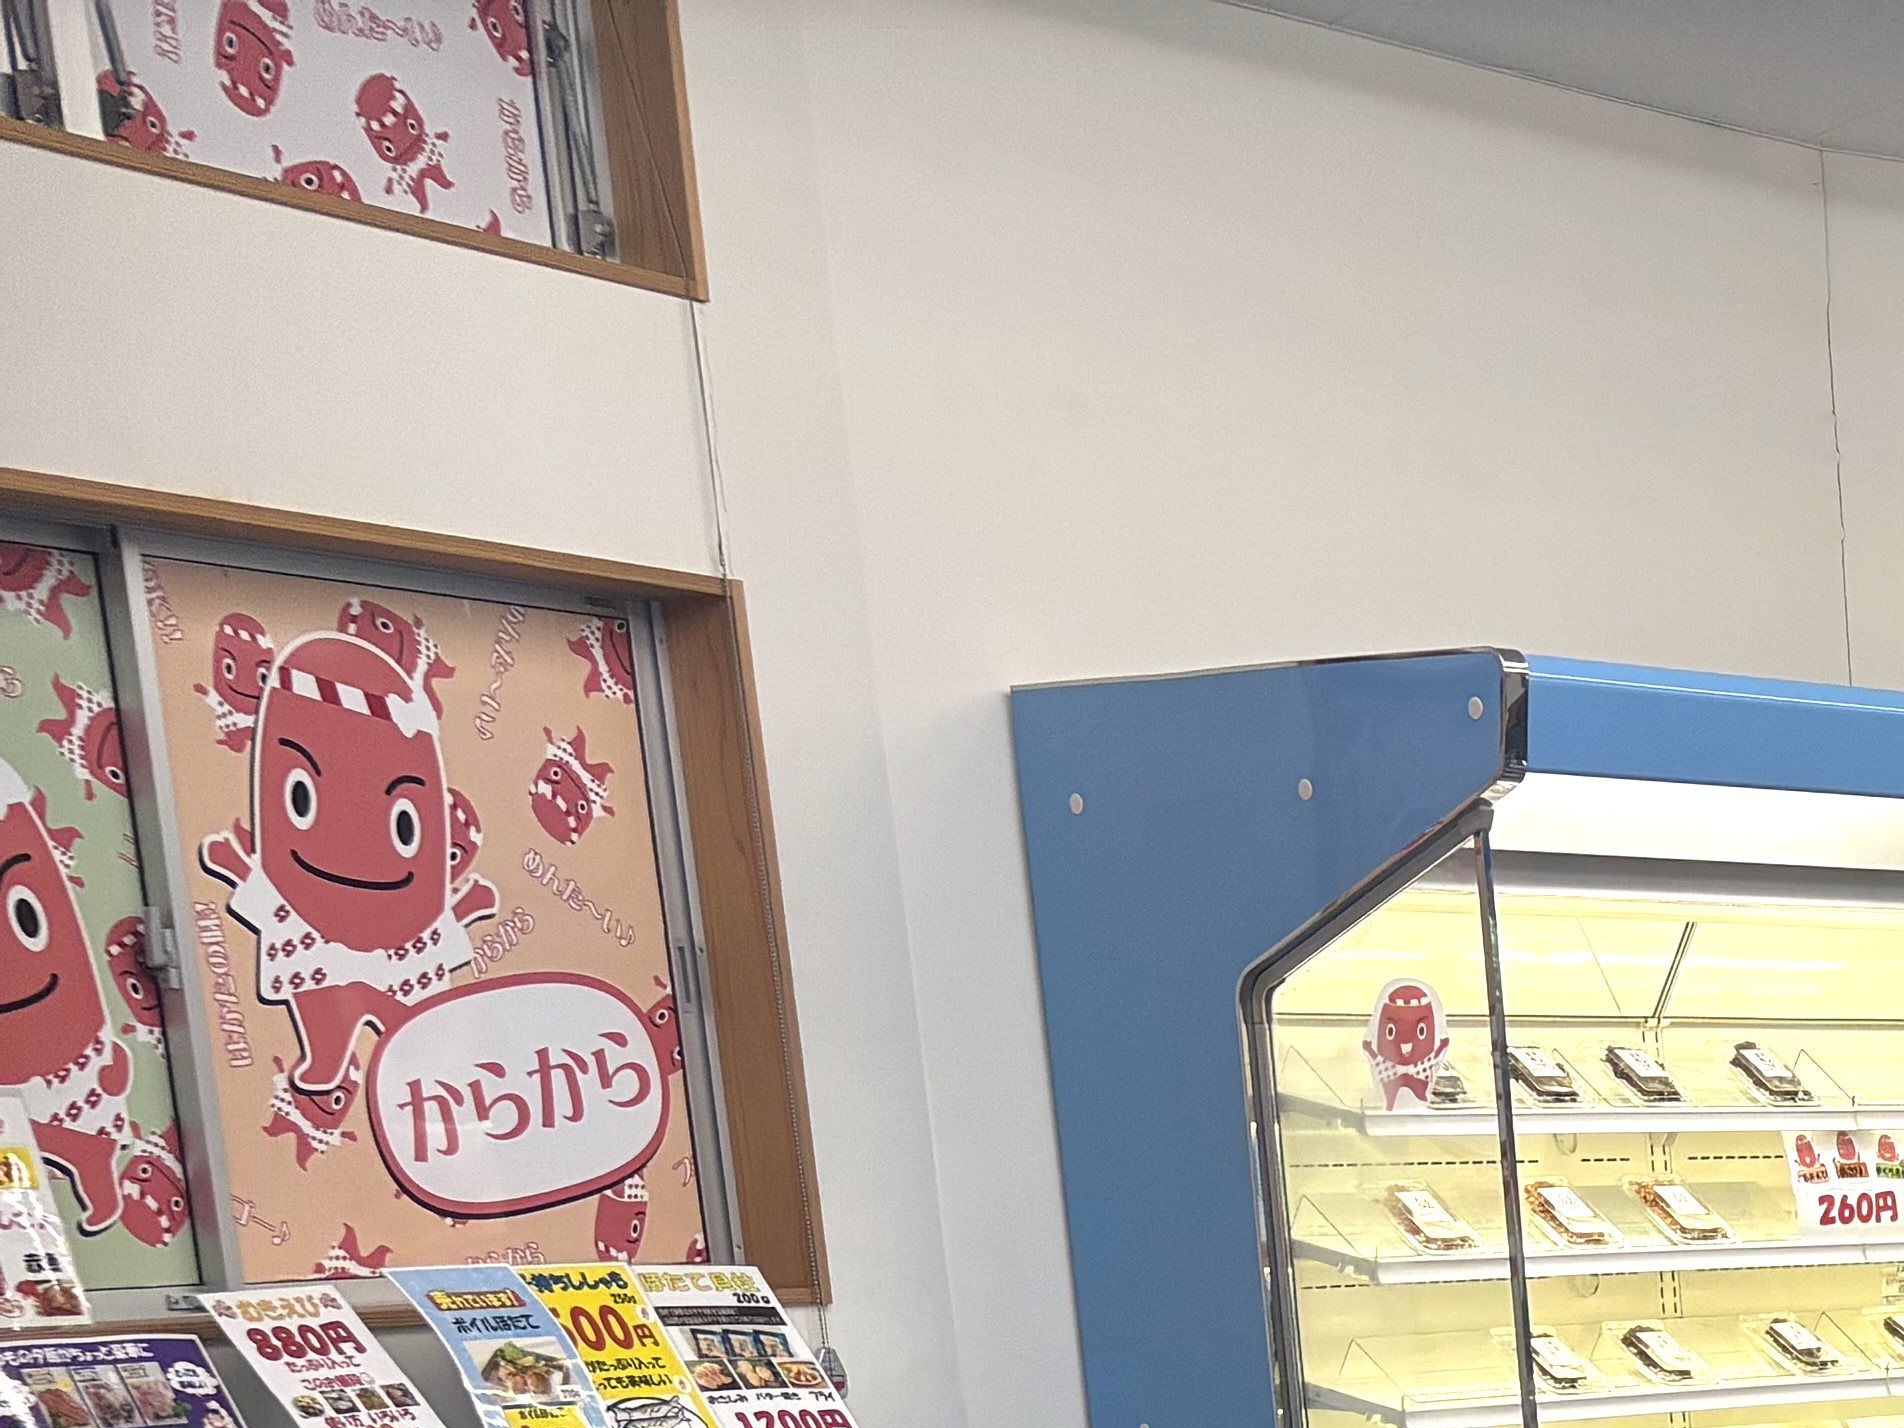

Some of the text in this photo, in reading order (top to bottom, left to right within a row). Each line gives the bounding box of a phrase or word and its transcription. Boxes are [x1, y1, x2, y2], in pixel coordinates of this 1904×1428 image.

[396, 1030, 653, 1164] からから
[1818, 1190, 1899, 1226] 260円
[246, 1320, 368, 1361] 880円
[451, 1313, 542, 1334] ボイルほたて
[596, 1375, 673, 1391] っても美味しい
